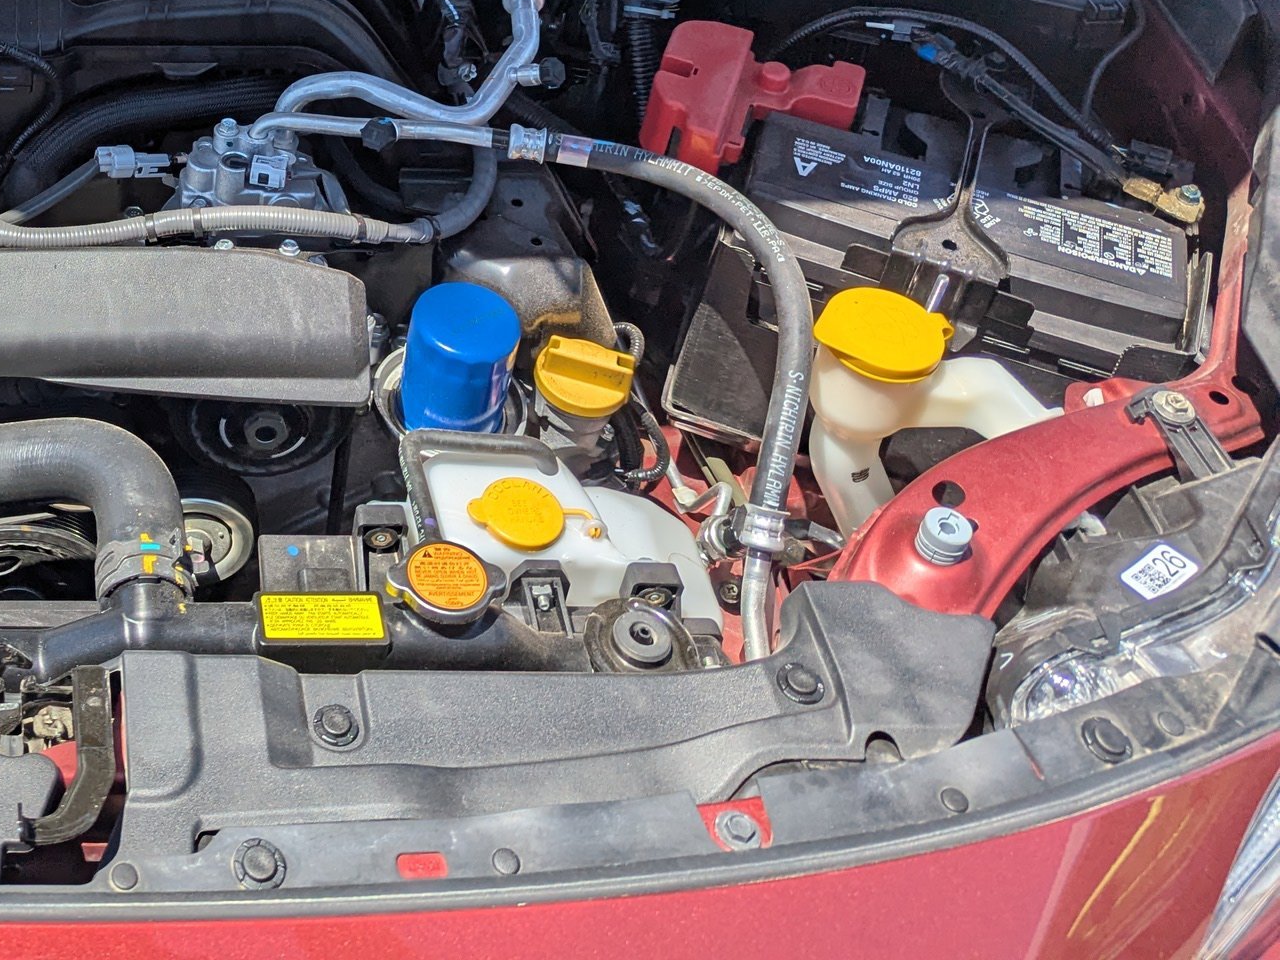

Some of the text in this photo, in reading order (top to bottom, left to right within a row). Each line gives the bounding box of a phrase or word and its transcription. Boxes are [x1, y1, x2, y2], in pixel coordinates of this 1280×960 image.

[840, 182, 918, 208] COLD CRANKING AMPS
[873, 185, 919, 202] 620 AMPS
[878, 180, 919, 195] GROUP SIZE
[902, 180, 920, 189] LN2
[1057, 245, 1137, 273] DANGER/POISON
[1152, 550, 1187, 577] 26
